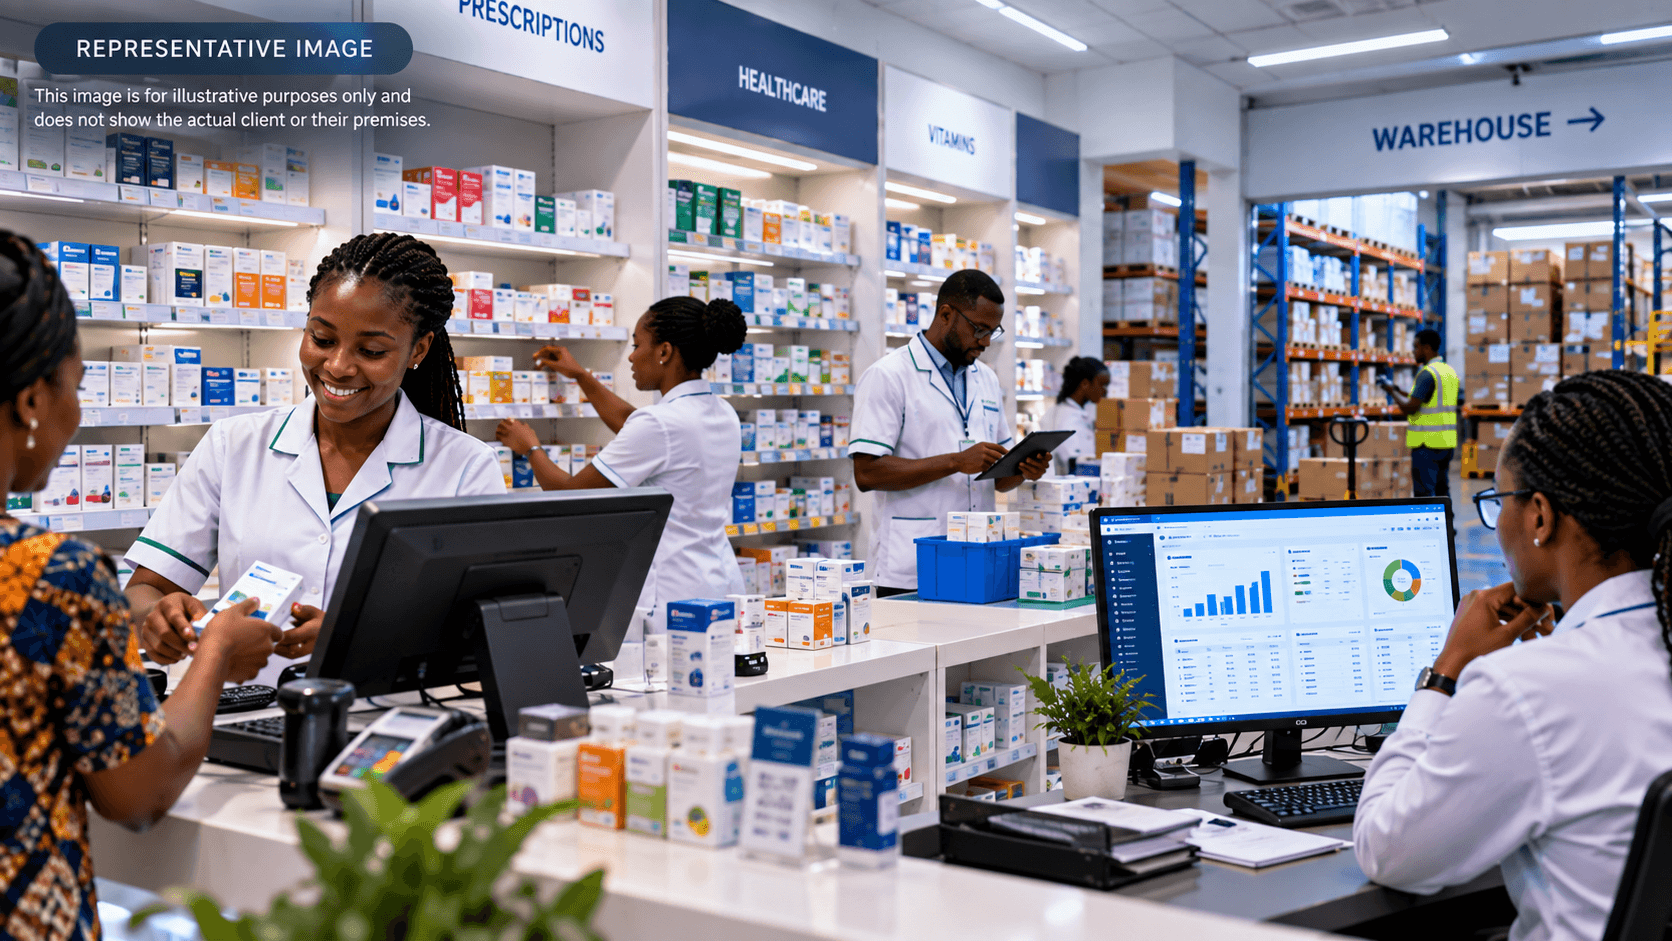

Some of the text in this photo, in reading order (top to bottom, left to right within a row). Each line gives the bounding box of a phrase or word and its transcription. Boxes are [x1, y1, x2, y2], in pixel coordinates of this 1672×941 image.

[459, 0, 605, 53] PRESCRIPTIONS
[739, 65, 827, 112] HEALTHCARE
[928, 123, 976, 156] VITAMINS
[1372, 111, 1552, 152] WAREHOUSE
